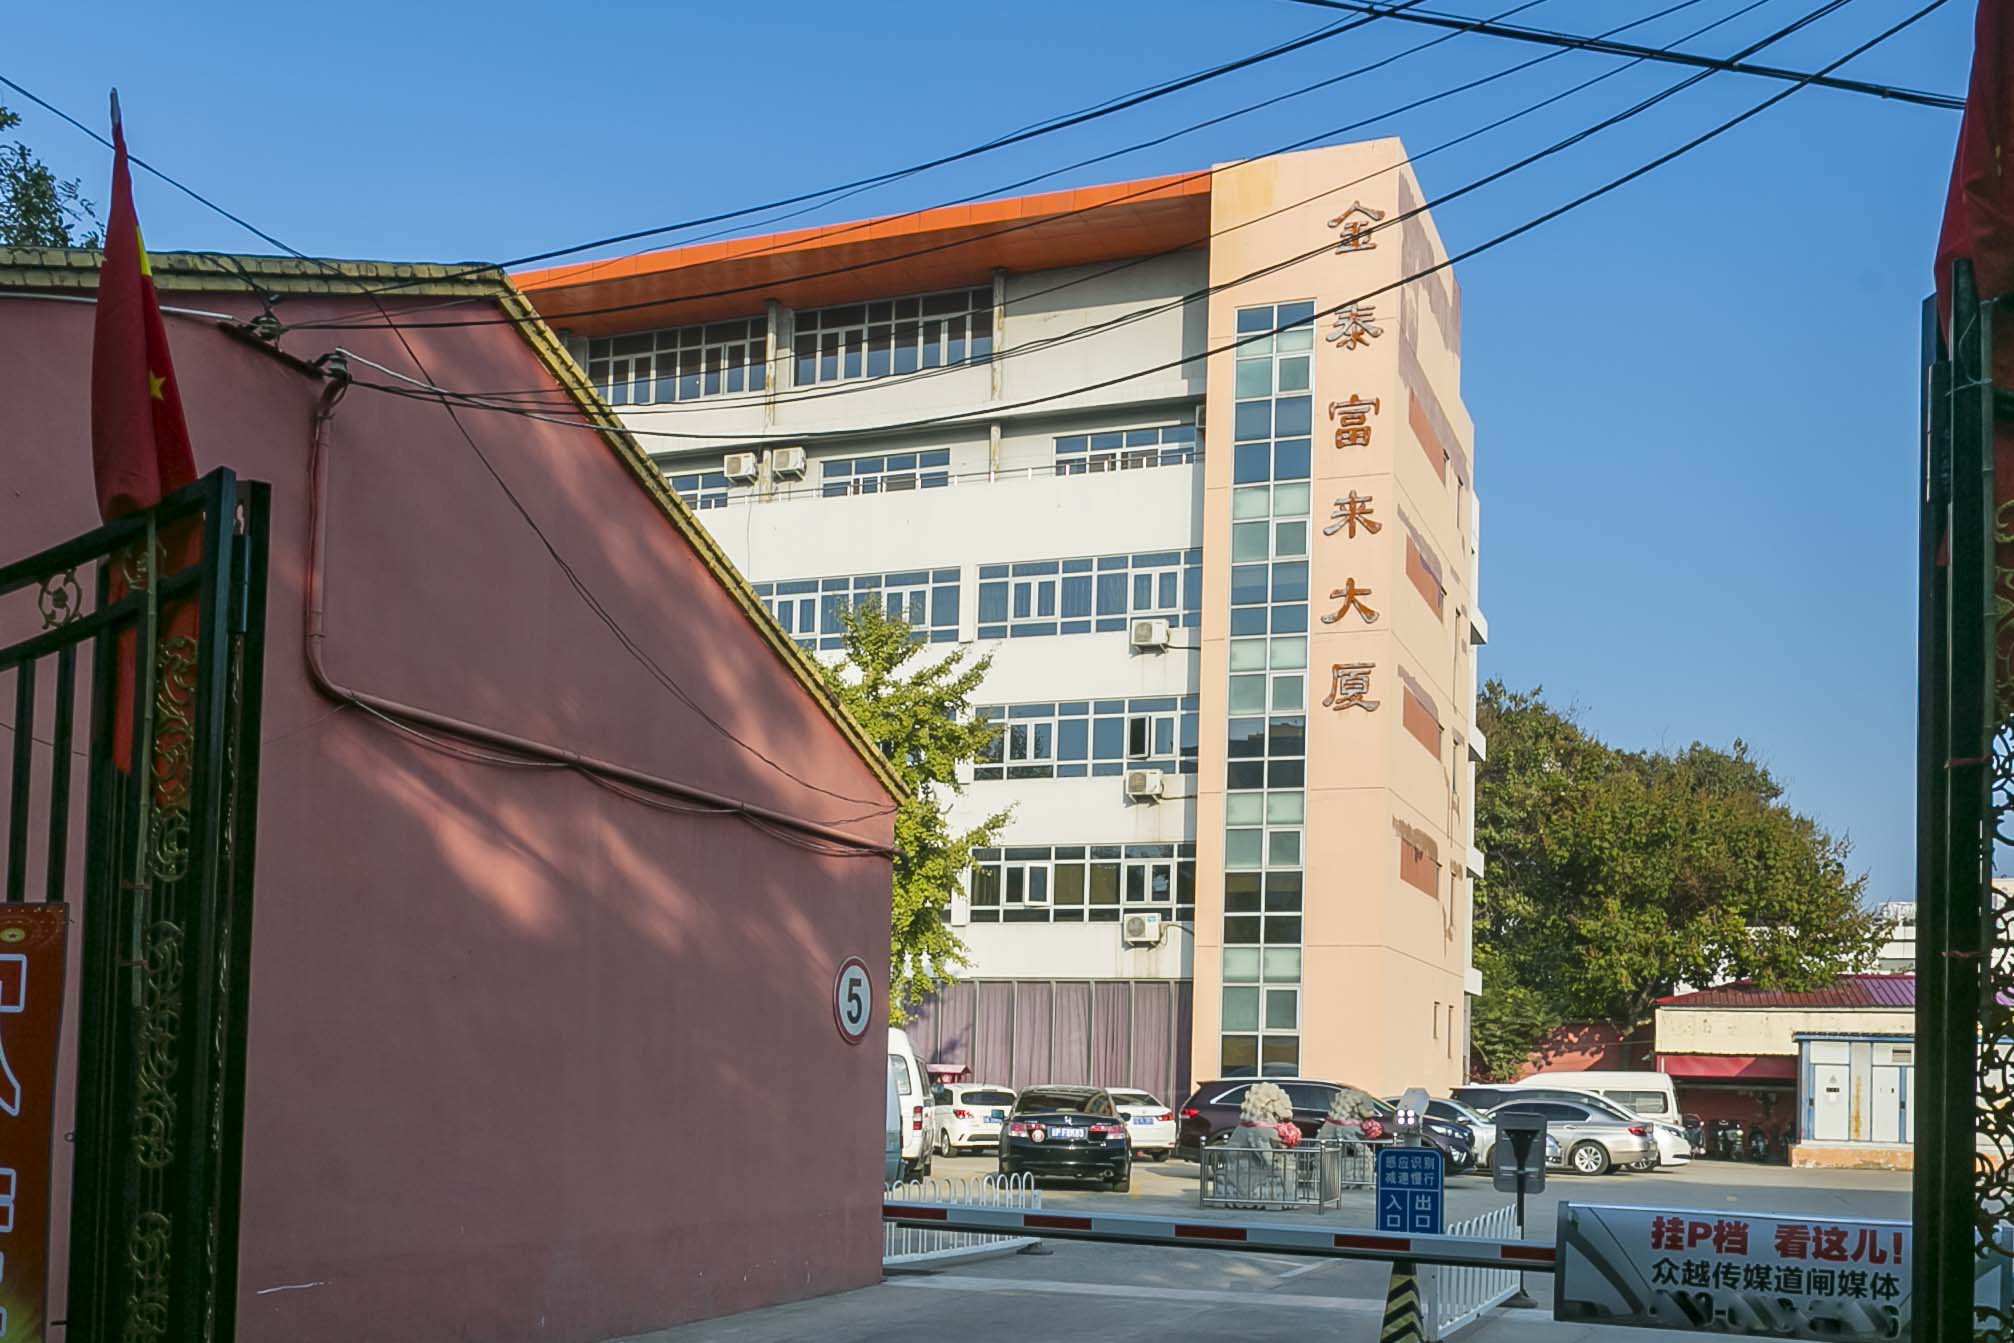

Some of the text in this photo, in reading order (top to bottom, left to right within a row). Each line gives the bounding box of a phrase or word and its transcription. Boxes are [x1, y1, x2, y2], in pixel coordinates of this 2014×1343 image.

[1321, 200, 1385, 712] 金泰富来大厦
[847, 978, 862, 1024] 5
[1386, 1194, 1402, 1227] 入口
[1415, 1194, 1432, 1227] 出口
[1651, 1216, 1749, 1256] 挂P档
[1651, 1257, 1900, 1301] 众越传媒道闸媒体
